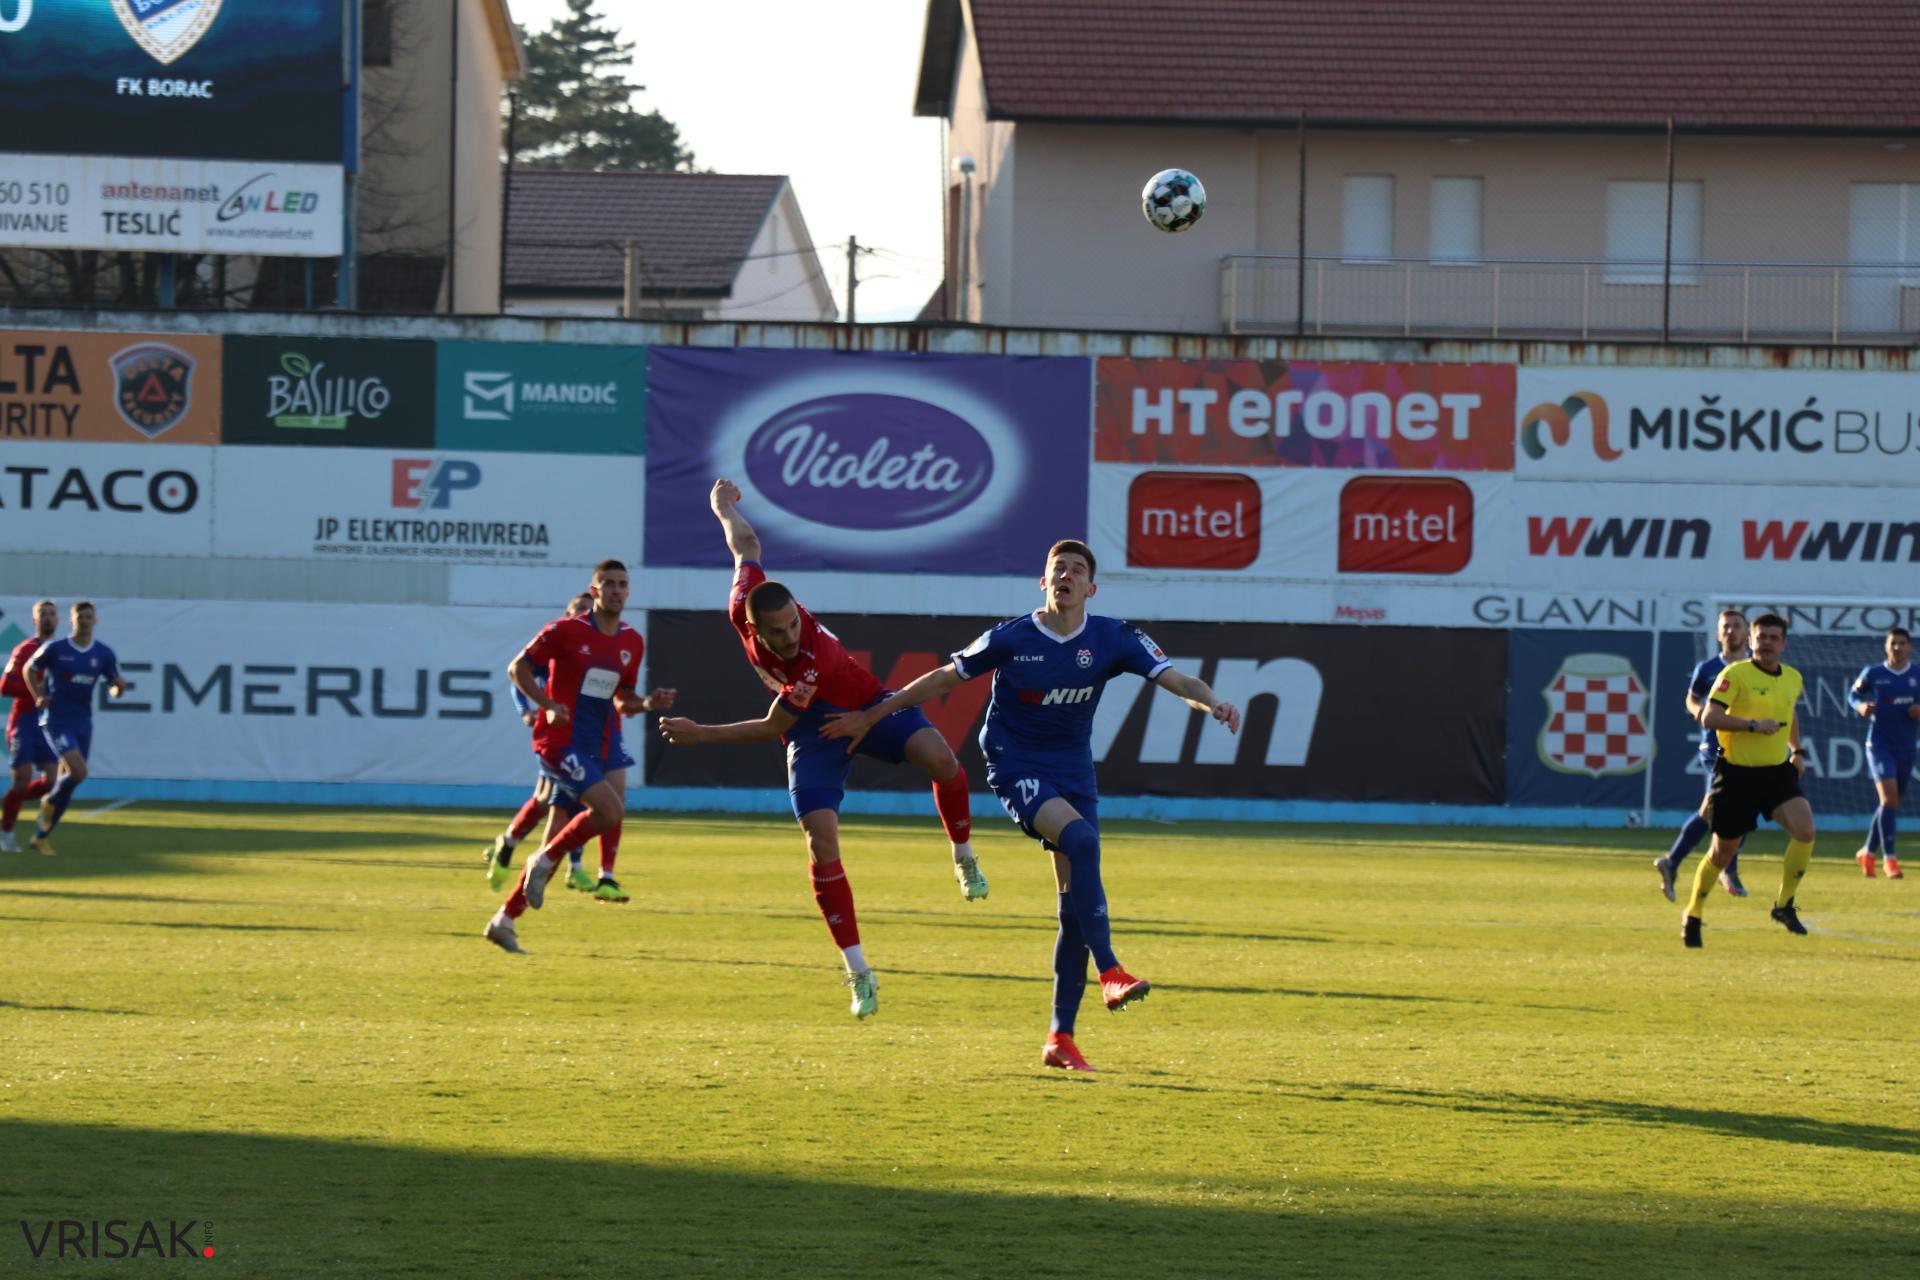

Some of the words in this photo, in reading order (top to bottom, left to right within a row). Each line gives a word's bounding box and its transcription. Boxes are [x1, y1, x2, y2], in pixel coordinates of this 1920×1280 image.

[116, 77, 143, 95] FK
[148, 78, 213, 98] BORAC
[28, 183, 69, 205] 510
[102, 181, 220, 202] antenanet
[102, 209, 182, 236] TESLIĆ
[266, 361, 391, 426] BASILICO
[521, 380, 617, 405] MANDIĆ
[0, 403, 81, 437] RITY
[1132, 388, 1219, 436] HT
[1629, 395, 1824, 453] MIŠKIĆ
[774, 424, 964, 492] Violeta
[0, 466, 199, 515] TACO
[315, 518, 340, 541] JP
[348, 519, 550, 547] ELEKTROPRIVREDA
[1141, 502, 1246, 539] m:tel
[1353, 505, 1458, 543] m:tel
[1472, 595, 1657, 626] GLAVNI
